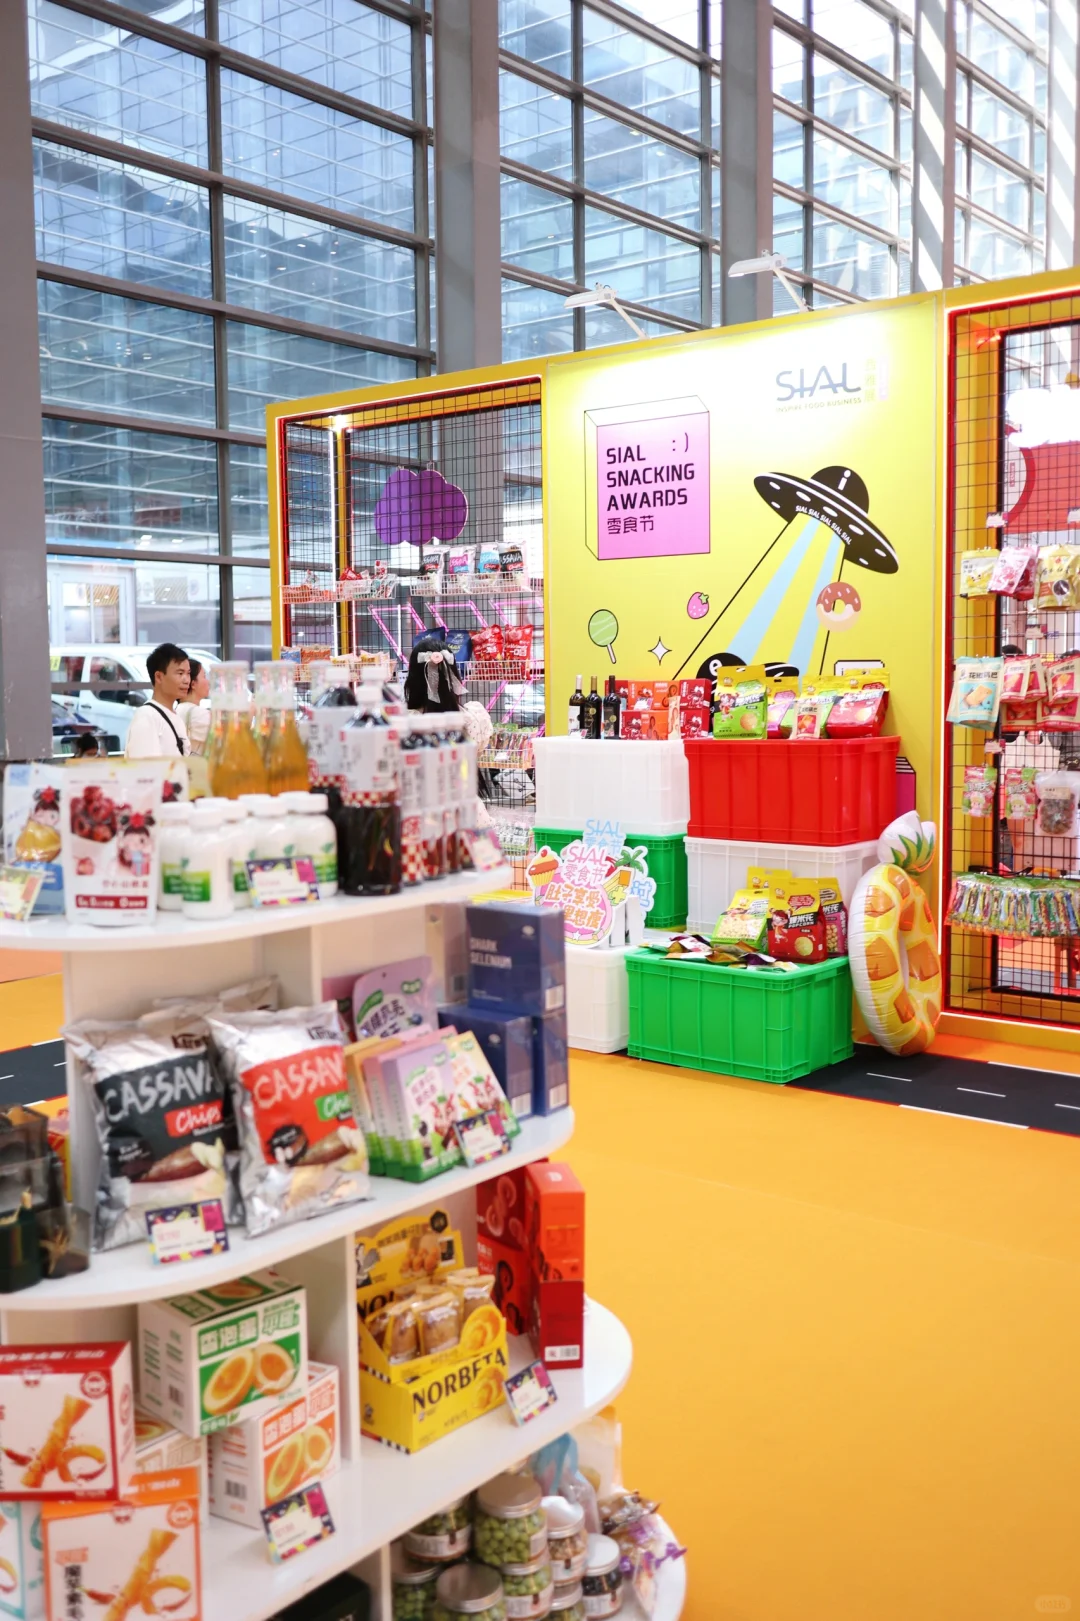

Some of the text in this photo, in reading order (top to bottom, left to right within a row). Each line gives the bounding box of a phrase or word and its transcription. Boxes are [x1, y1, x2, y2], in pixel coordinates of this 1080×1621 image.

[776, 362, 862, 401] SIAL
[776, 397, 862, 413] INSPIRE FOOD BUSINESS
[606, 444, 646, 465] SIAL
[606, 463, 695, 488] SNACKING
[606, 488, 688, 511] AWARDS
[607, 515, 654, 535] 零食节
[795, 505, 852, 545] SIAL SIAL SIAL SIAL SIAL
[586, 819, 624, 838] SIAL
[567, 845, 608, 867] SIAL
[564, 863, 606, 883] 零食节
[545, 884, 600, 909] 肚子享受
[553, 904, 604, 930] 里想瘦
[470, 937, 498, 953] SHARK
[253, 1052, 344, 1110] CASSAV
[175, 1104, 221, 1134] Chips
[413, 1347, 507, 1413] NORBETA
